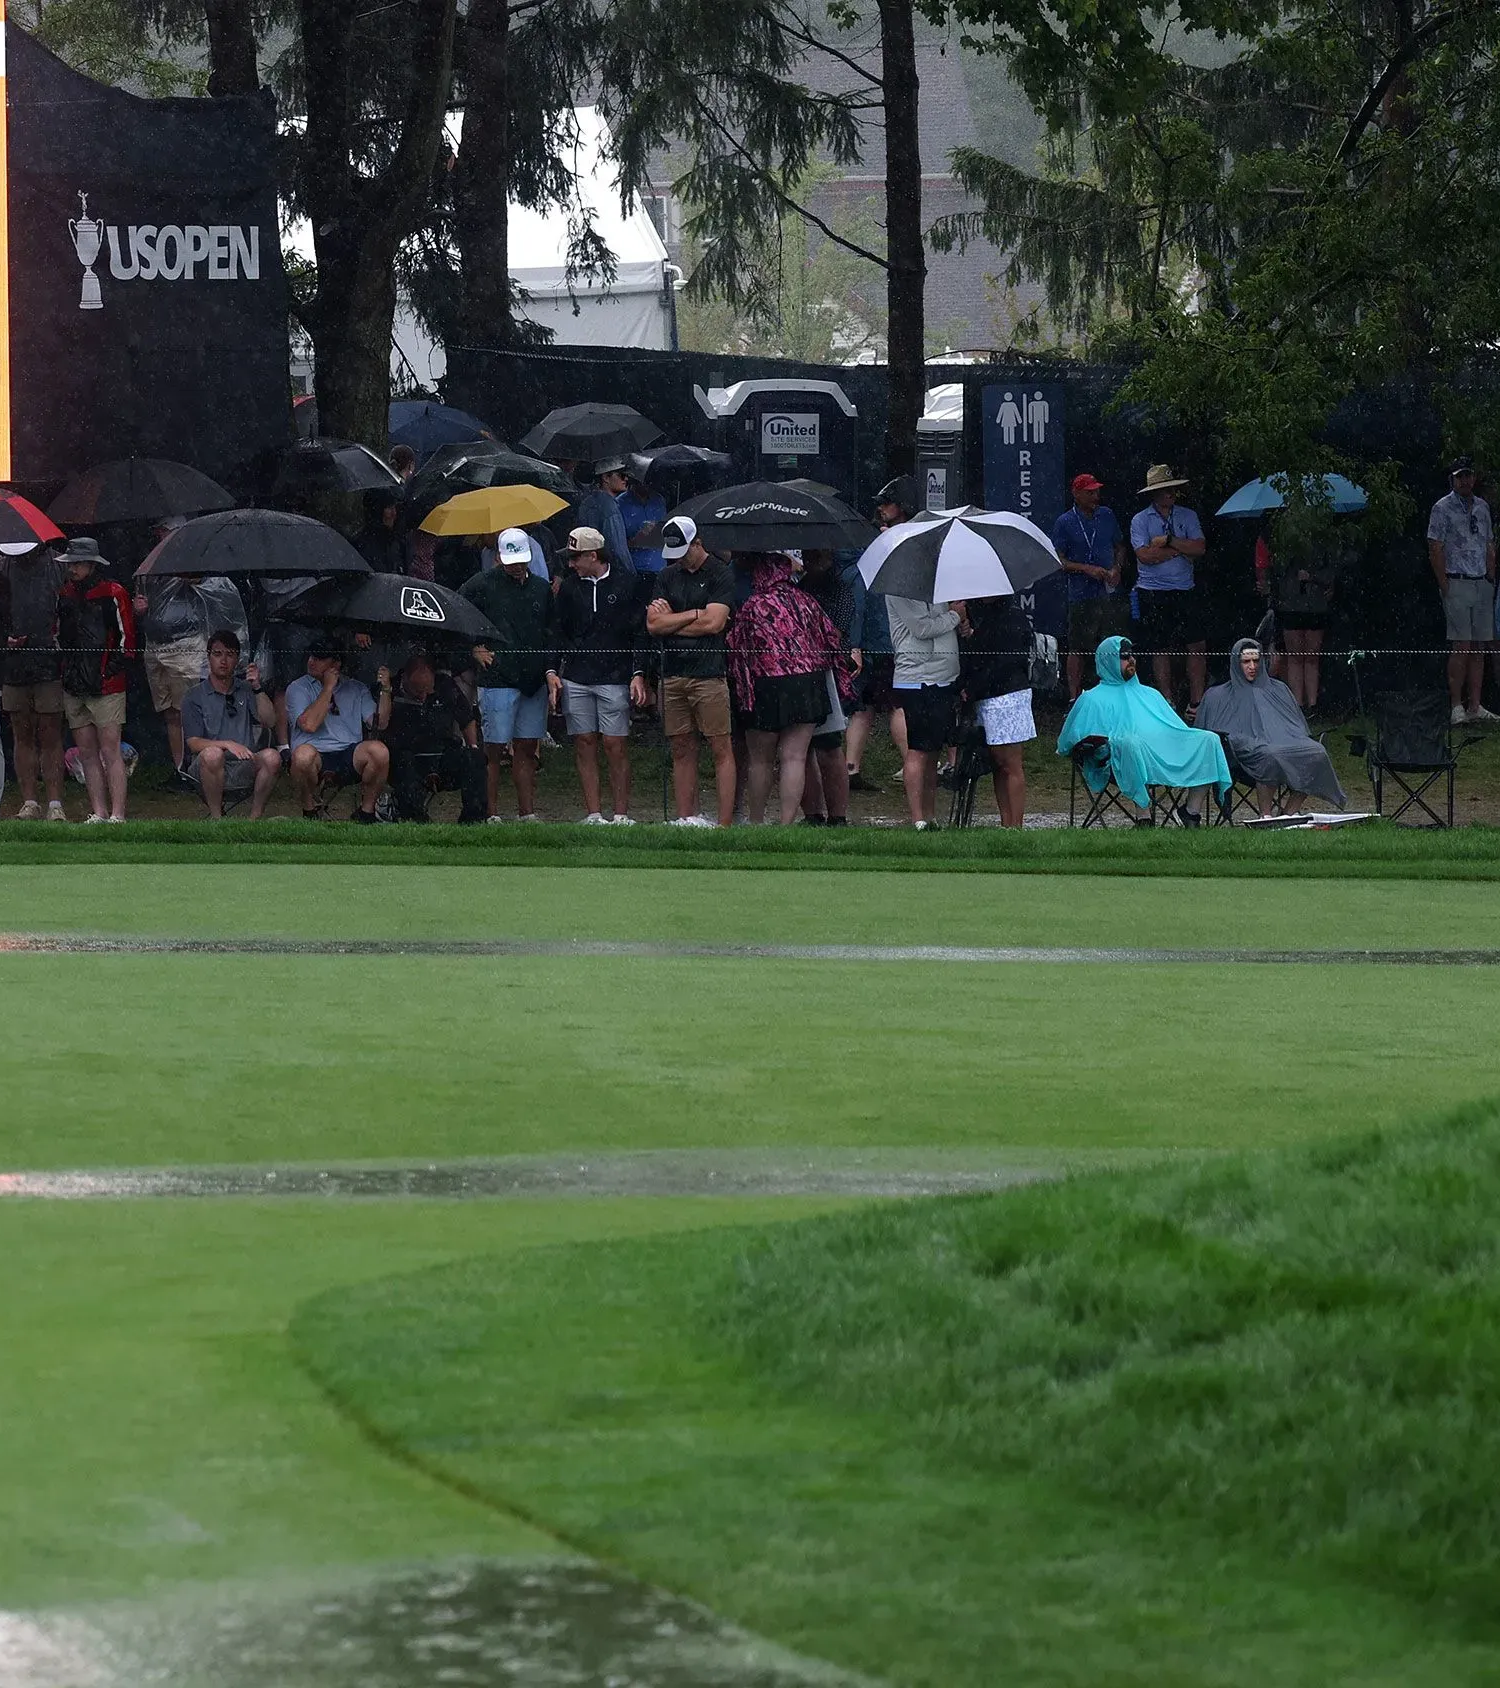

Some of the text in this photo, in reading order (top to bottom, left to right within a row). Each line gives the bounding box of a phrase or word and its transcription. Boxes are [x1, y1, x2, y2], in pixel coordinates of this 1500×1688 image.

[770, 423, 816, 436] United
[715, 502, 809, 519] TaylorMade
[406, 608, 440, 619] PING
